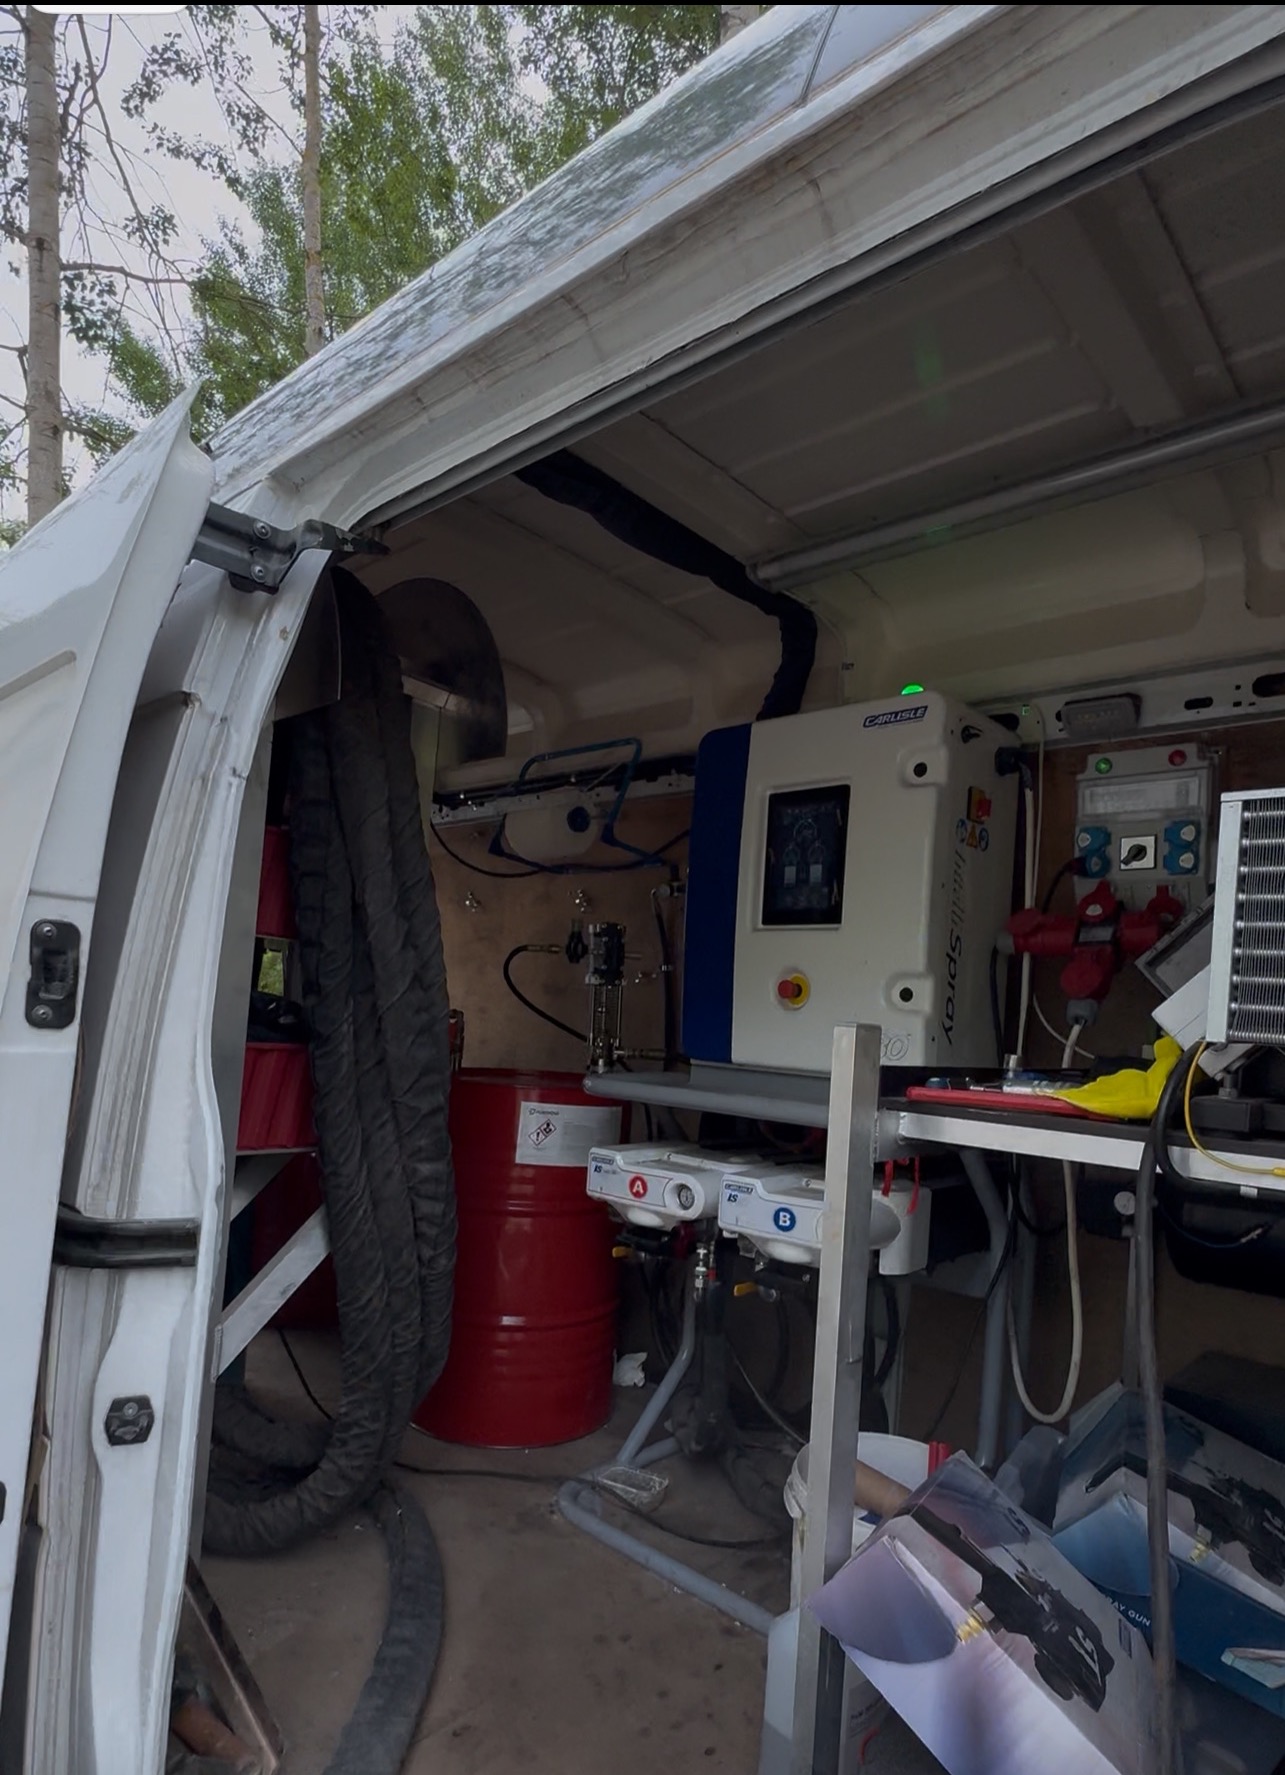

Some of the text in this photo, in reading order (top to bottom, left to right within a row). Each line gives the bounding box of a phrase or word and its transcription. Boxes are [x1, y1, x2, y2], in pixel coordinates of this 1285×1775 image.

[864, 707, 927, 727] CARLISLE
[632, 1179, 645, 1195] A
[727, 1193, 739, 1203] IS
[778, 1211, 792, 1228] B
[1127, 1609, 1151, 1628] GUN
